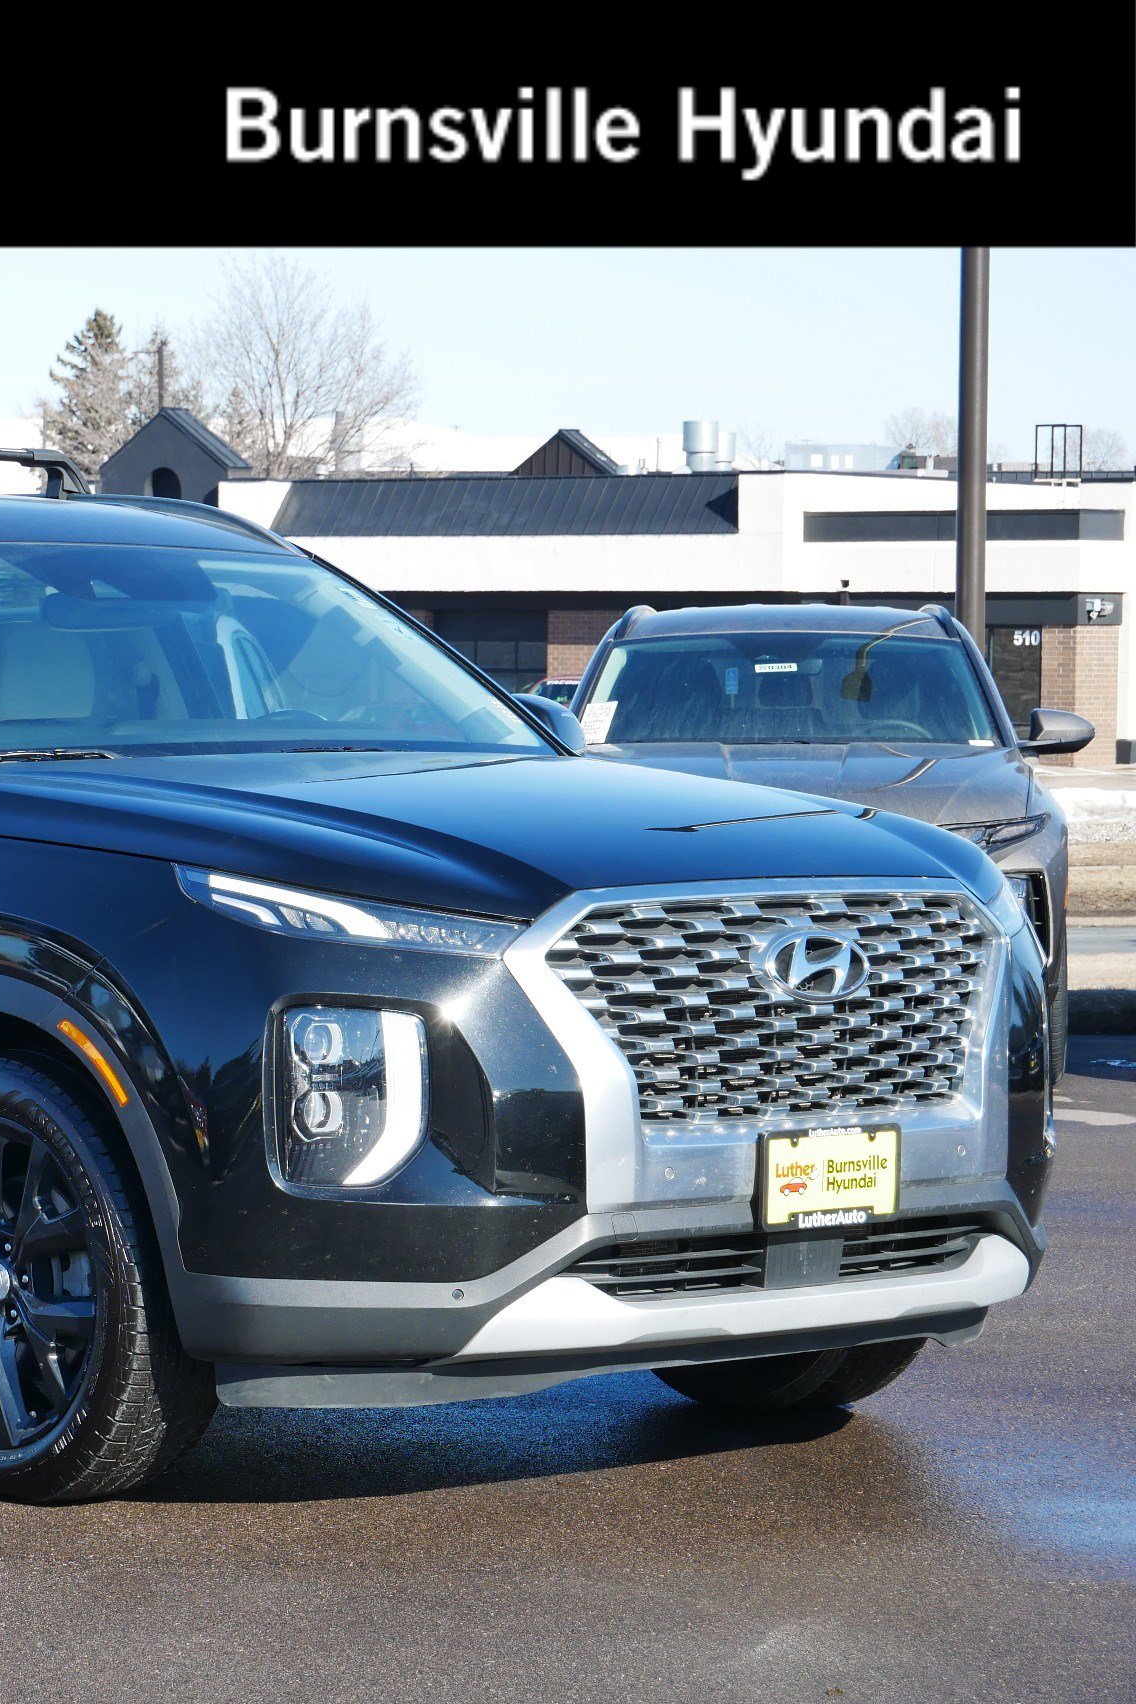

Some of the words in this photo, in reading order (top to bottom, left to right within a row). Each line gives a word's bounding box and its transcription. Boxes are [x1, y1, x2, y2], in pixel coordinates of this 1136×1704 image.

[1013, 630, 1040, 646] 510
[809, 1127, 862, 1138] LutherAuto.com
[775, 1162, 815, 1179] Luther
[827, 1155, 887, 1173] Burnsville
[826, 1174, 876, 1194] Hyundai
[798, 1210, 866, 1229] LutherAuto
